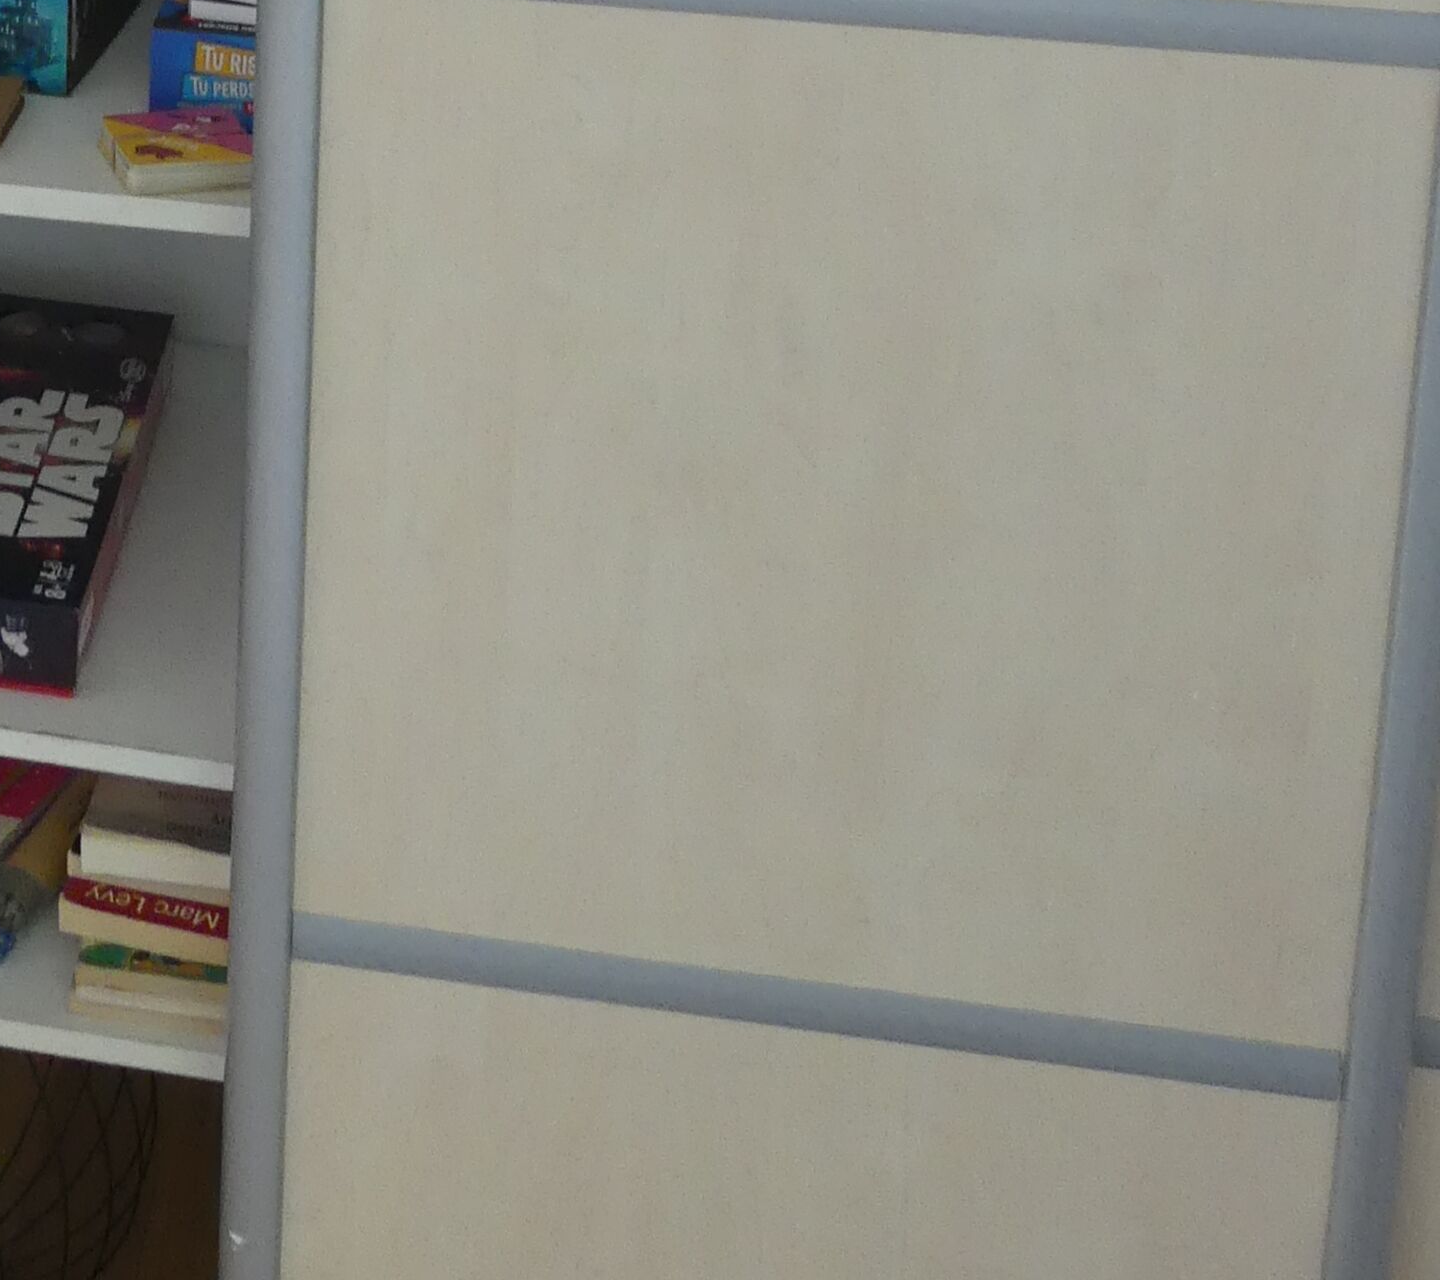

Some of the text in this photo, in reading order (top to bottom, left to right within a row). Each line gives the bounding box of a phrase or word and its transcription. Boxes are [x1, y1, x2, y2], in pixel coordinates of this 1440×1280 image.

[16, 392, 124, 538] WARS
[85, 885, 221, 929] Marc Levy
